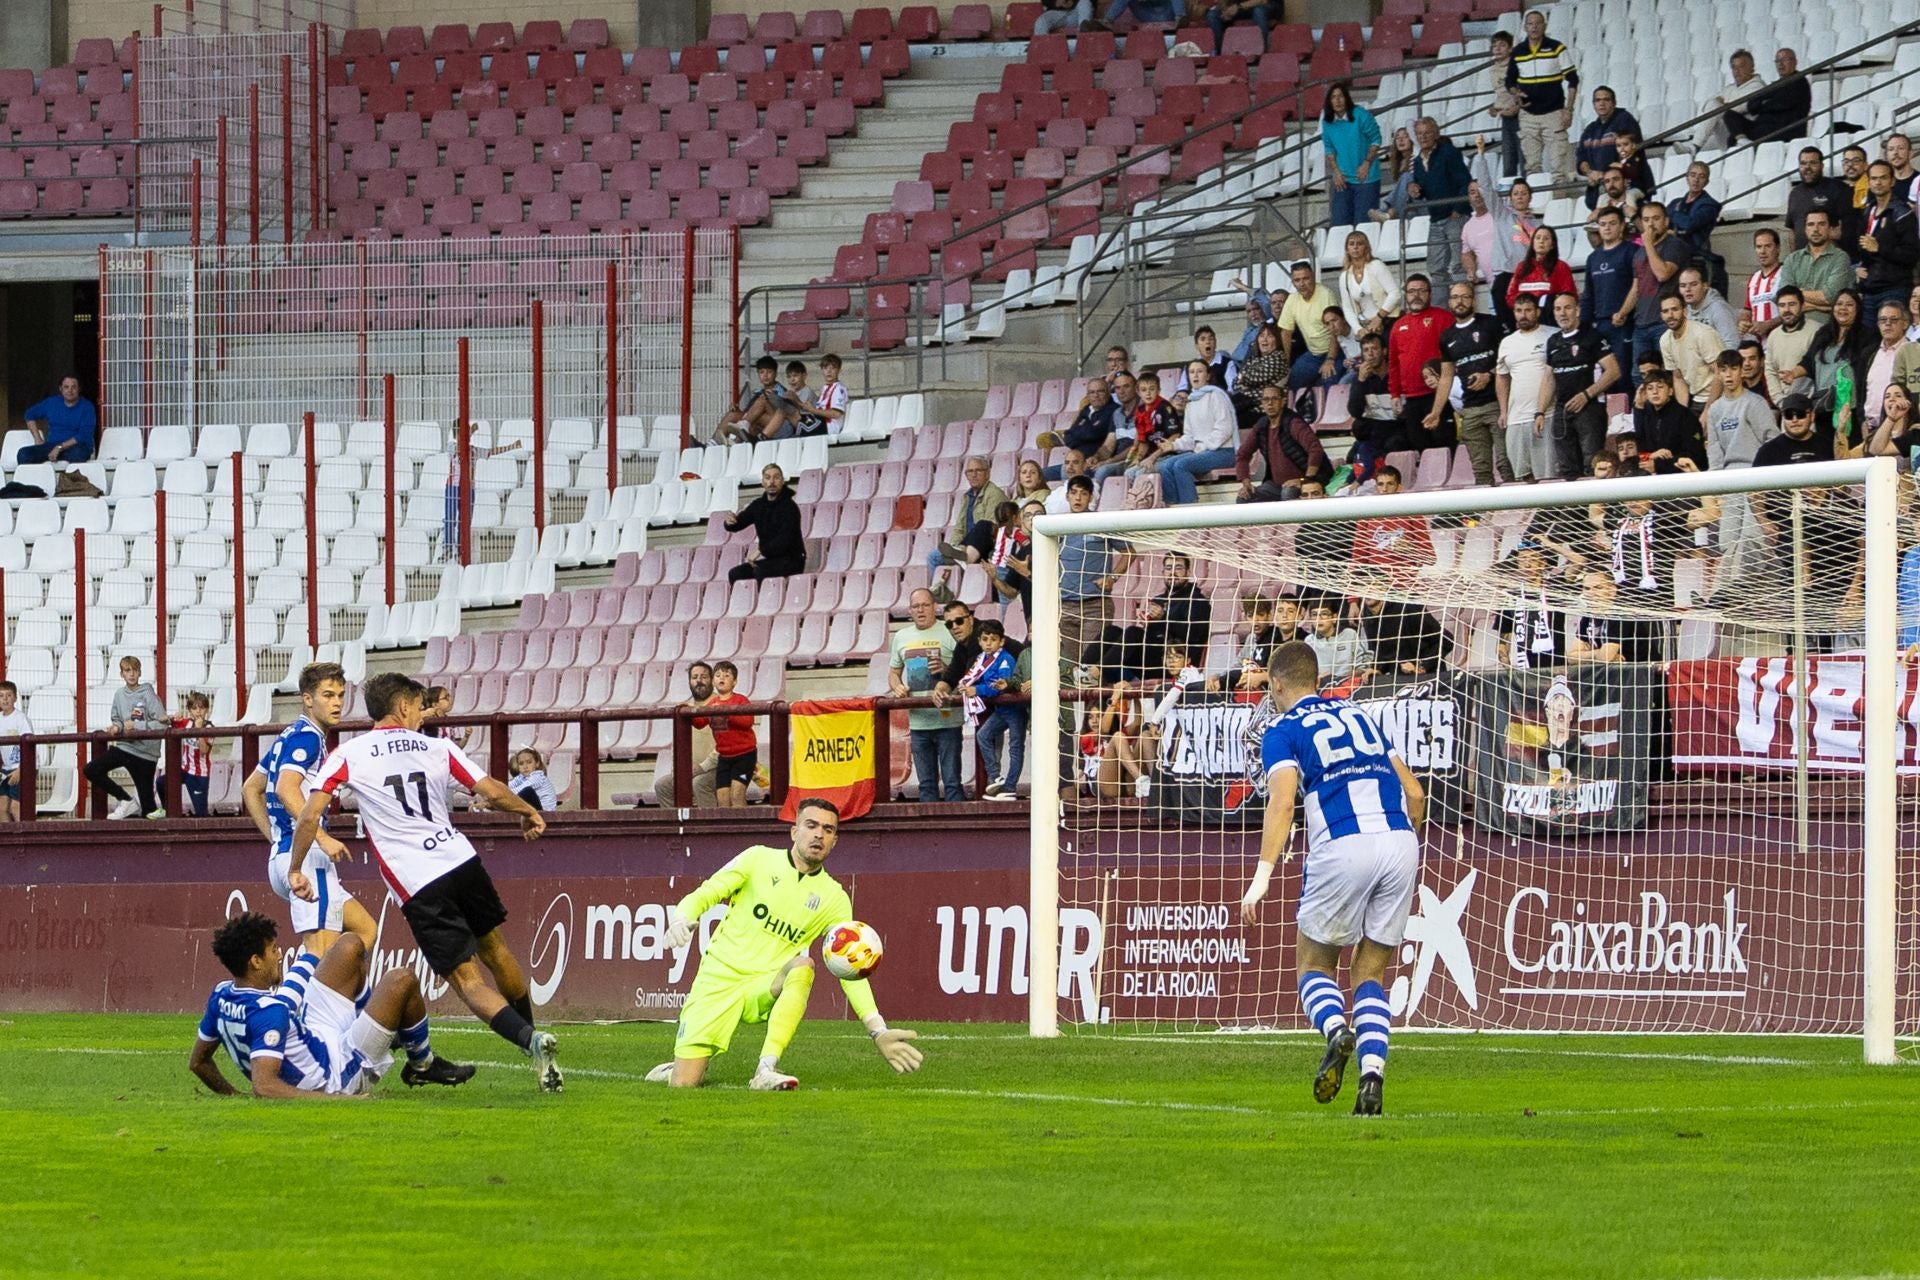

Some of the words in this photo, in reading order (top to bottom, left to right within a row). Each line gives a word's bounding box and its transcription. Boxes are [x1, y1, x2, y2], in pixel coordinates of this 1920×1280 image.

[932, 46, 946, 56] 23
[108, 259, 145, 271] SALID
[371, 744, 384, 757] J.
[387, 738, 429, 755] FEBAS
[1301, 706, 1385, 768] 20
[383, 771, 434, 823] 11
[1126, 905, 1229, 932] UNIVERSIDAD
[1503, 887, 1748, 974] CaixaBank
[1124, 938, 1250, 964] INTERNACIONAL
[1123, 973, 1146, 997] DE
[1146, 973, 1167, 997] LA
[1170, 972, 1217, 998] RIOJA
